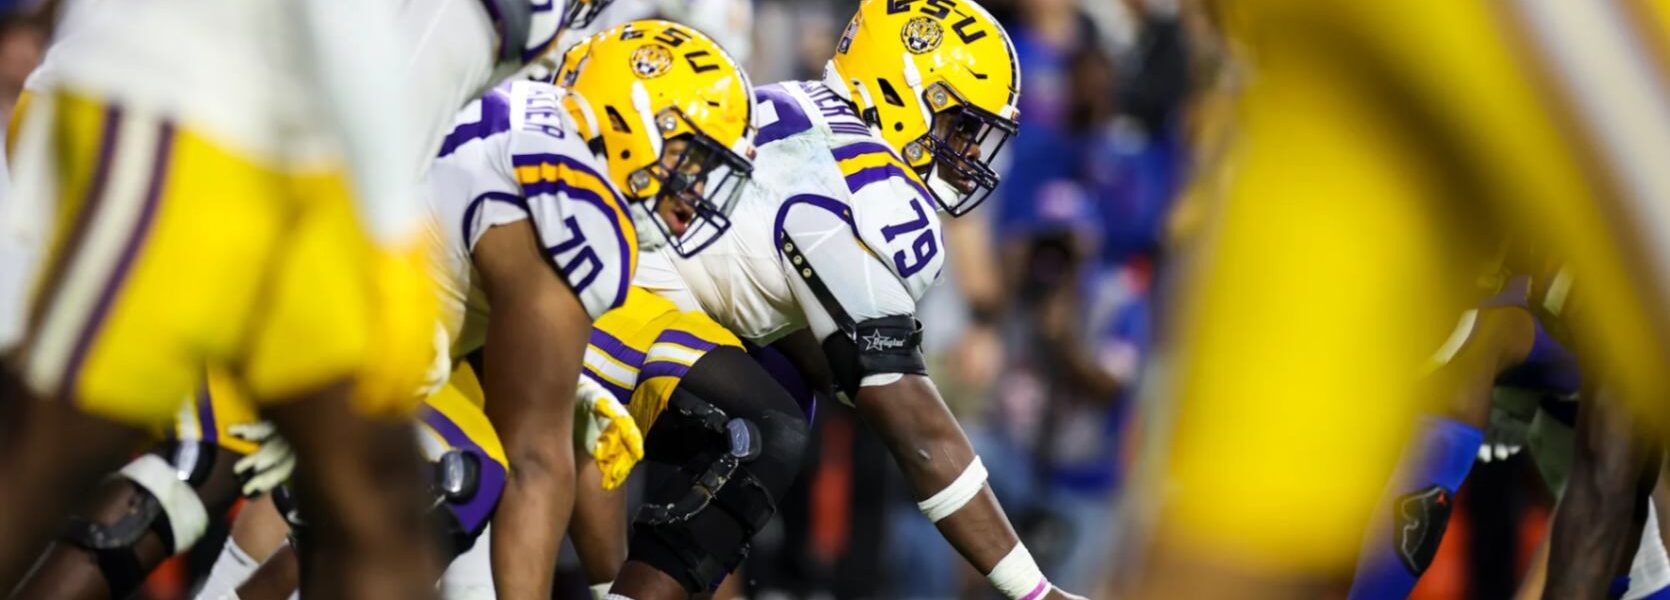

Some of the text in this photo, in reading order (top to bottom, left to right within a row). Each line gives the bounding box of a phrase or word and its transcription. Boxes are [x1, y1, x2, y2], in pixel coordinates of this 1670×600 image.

[886, 0, 987, 44] LSU
[828, 122, 872, 137] III
[545, 214, 604, 295] 70
[880, 198, 938, 279] 79
